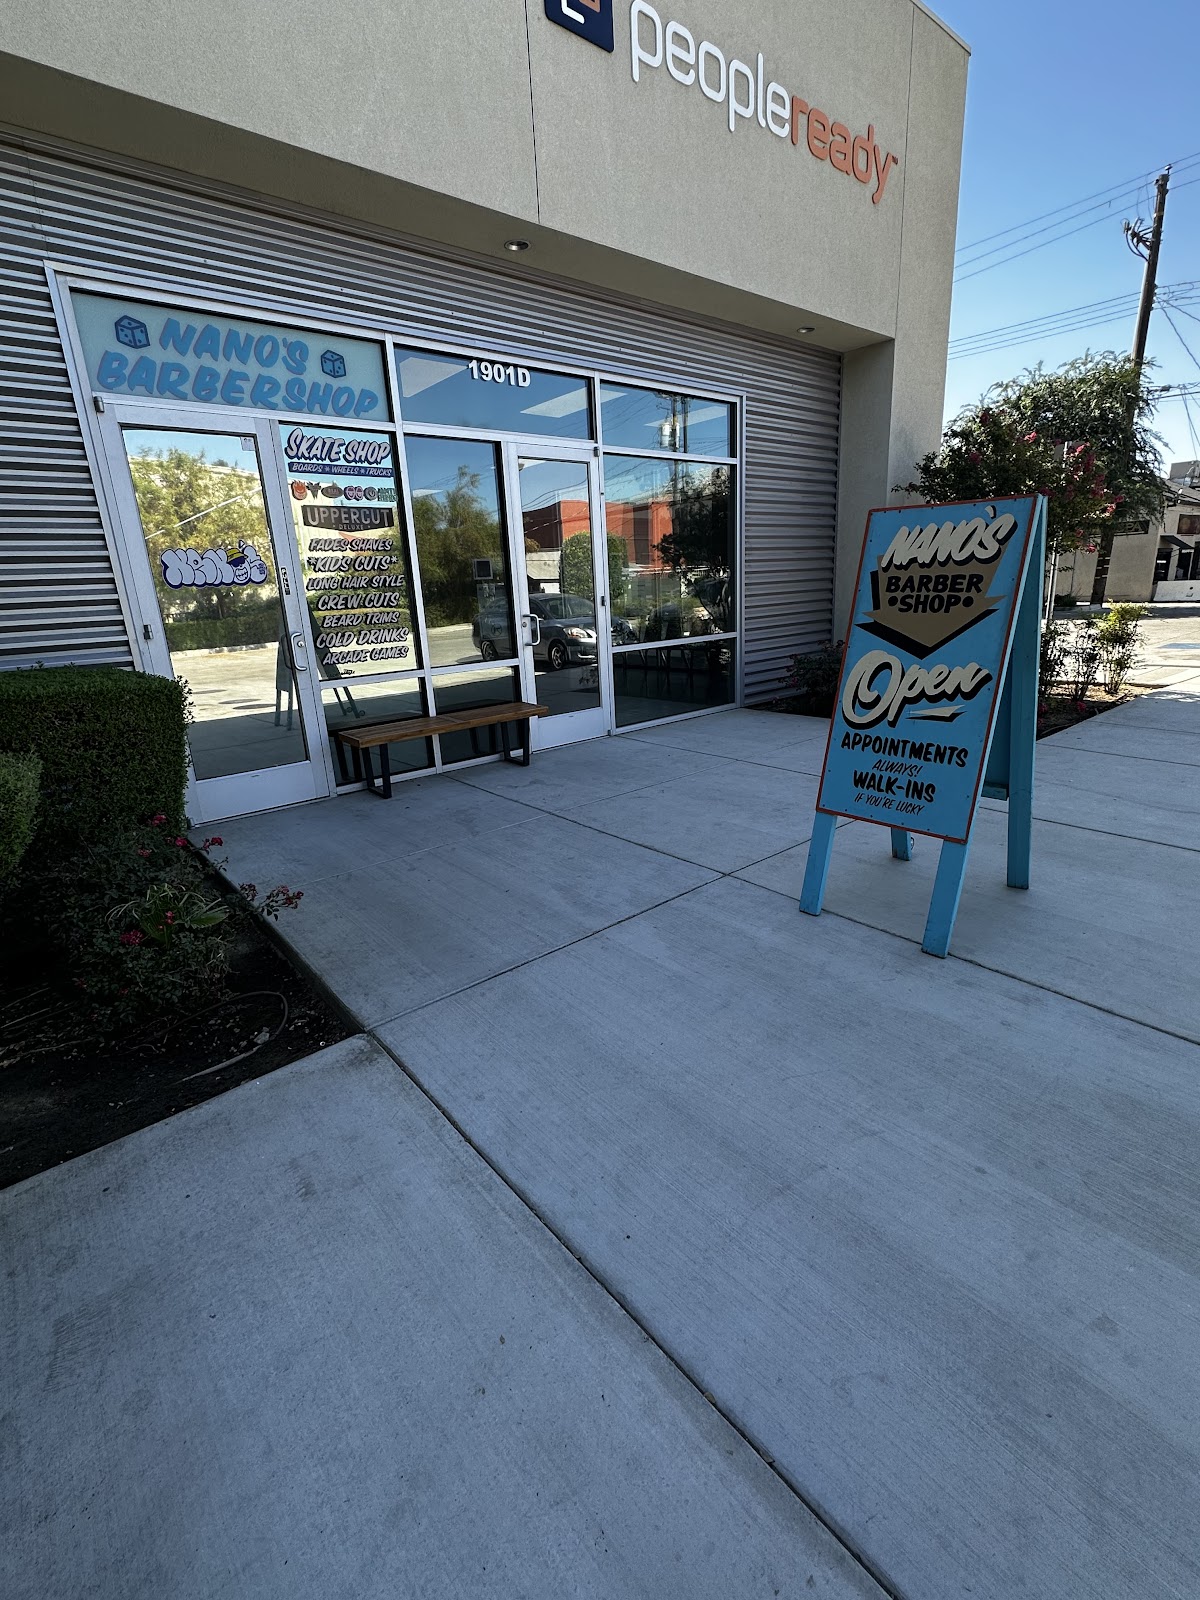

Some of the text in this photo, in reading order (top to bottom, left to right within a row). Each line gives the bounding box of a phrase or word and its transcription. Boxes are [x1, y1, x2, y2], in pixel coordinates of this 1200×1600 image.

[159, 318, 309, 375] NANO'S
[96, 350, 379, 417] BARBERSHOP
[468, 359, 531, 387] 1901D
[284, 427, 392, 465] SKATE SHOP
[292, 462, 393, 477] BOARDS WHEELS TRUCKS
[306, 507, 390, 527] UPPERCUT
[309, 538, 393, 552] FADES SHAVES
[880, 505, 1018, 573] NANO'S
[306, 577, 339, 591] LONG
[340, 576, 370, 589] HAIR
[371, 575, 404, 588] STYLE
[885, 573, 984, 594] BARBER
[316, 592, 400, 610] CREW CUTS
[897, 594, 963, 613] SHOP
[321, 611, 400, 628] BEARD TRIMS
[315, 627, 409, 648] COLD DRINKS
[321, 646, 409, 665] ARCADE GAMES
[842, 650, 993, 730] Open
[841, 731, 968, 768] APPOINTMENTS
[872, 759, 923, 778] ALWAYS!
[853, 770, 936, 803] WALK-INS
[854, 792, 925, 816] IF YOU'RE LUCKY
